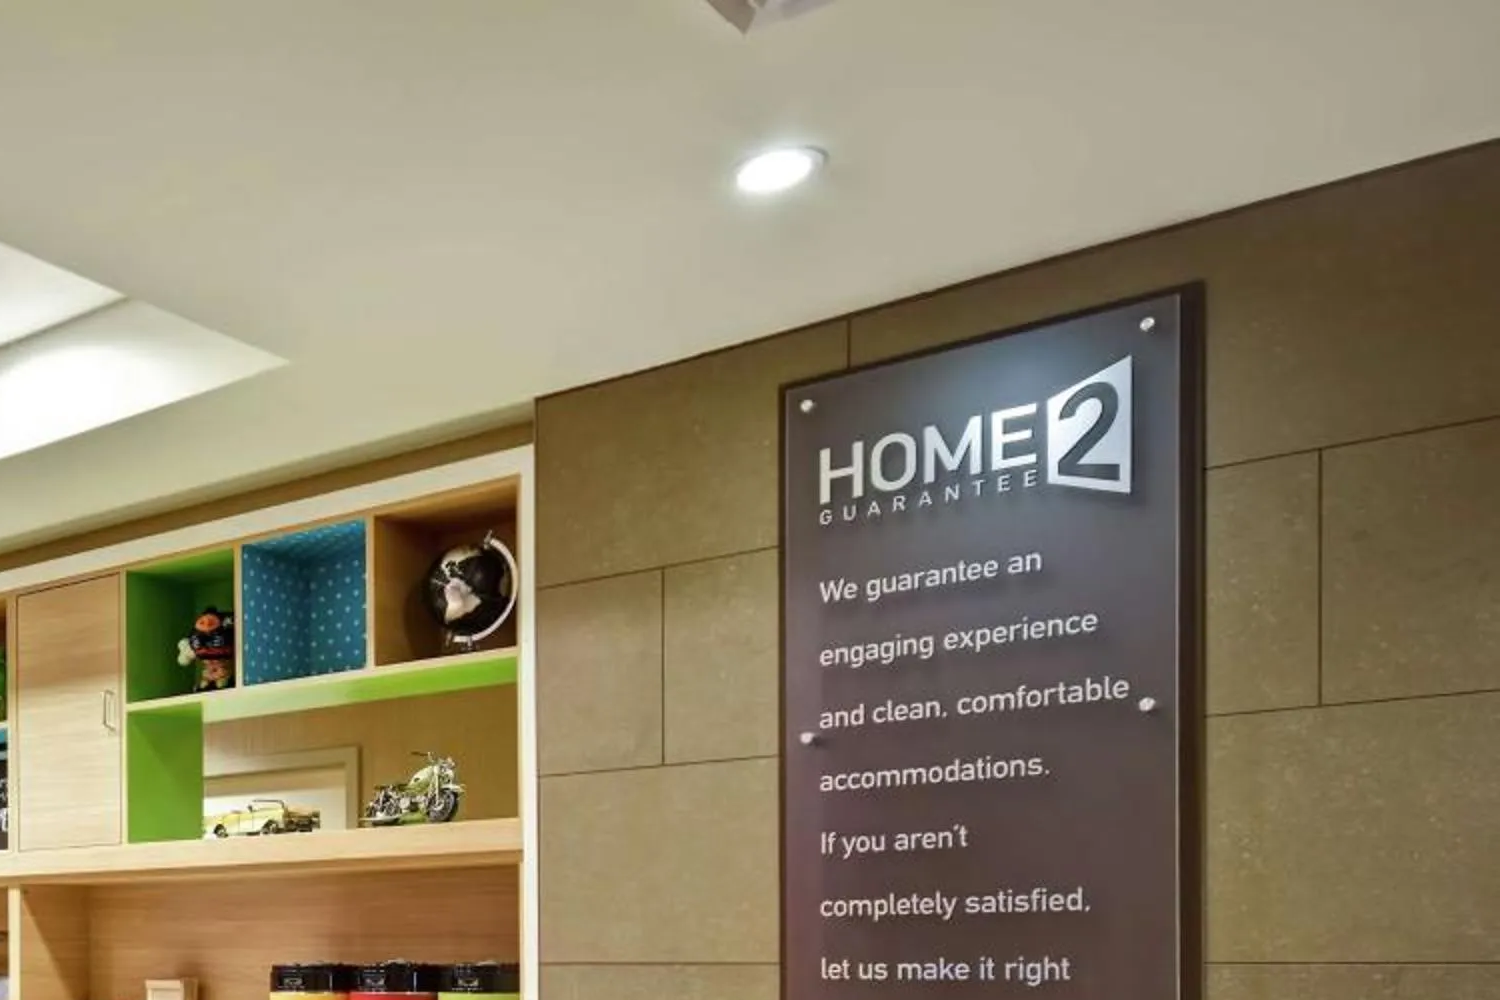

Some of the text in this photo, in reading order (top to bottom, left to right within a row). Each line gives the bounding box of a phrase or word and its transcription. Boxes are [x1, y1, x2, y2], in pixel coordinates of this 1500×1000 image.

[819, 469, 1039, 526] GUARANTEE
[819, 551, 1042, 604] We guarantee an
[819, 613, 1099, 669] engaging experience
[819, 703, 865, 730] and
[956, 675, 1131, 716] comfortable
[819, 757, 1051, 793] accommodations.
[819, 823, 969, 860] If you aren't
[819, 890, 958, 922] completely
[820, 955, 1071, 987] let us make it right
